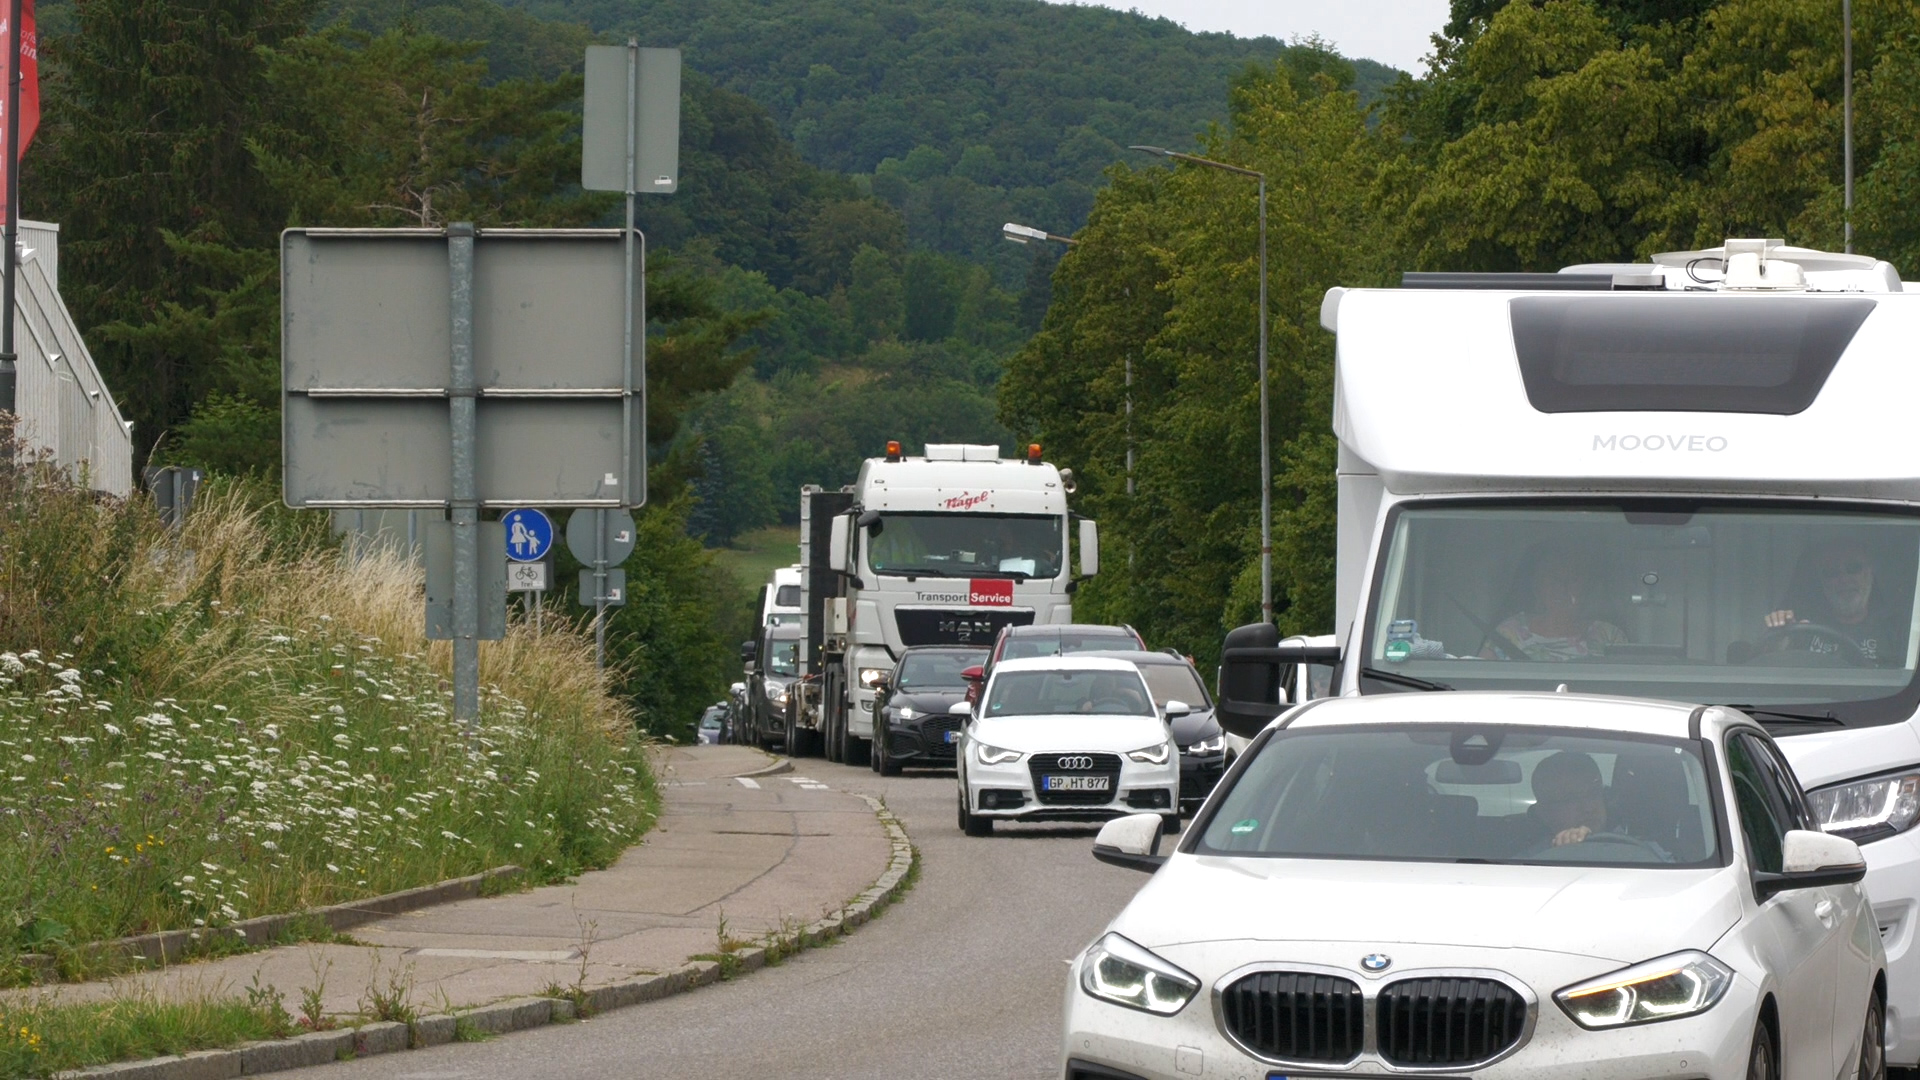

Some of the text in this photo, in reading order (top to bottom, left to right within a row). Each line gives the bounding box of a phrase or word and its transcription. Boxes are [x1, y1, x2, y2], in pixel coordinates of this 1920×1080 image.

[1592, 434, 1728, 453] MOOVEO
[944, 491, 989, 510] Nagel
[915, 591, 1011, 603] Transport Service
[939, 621, 991, 632] MAN
[1050, 778, 1108, 789] GP HT 877
